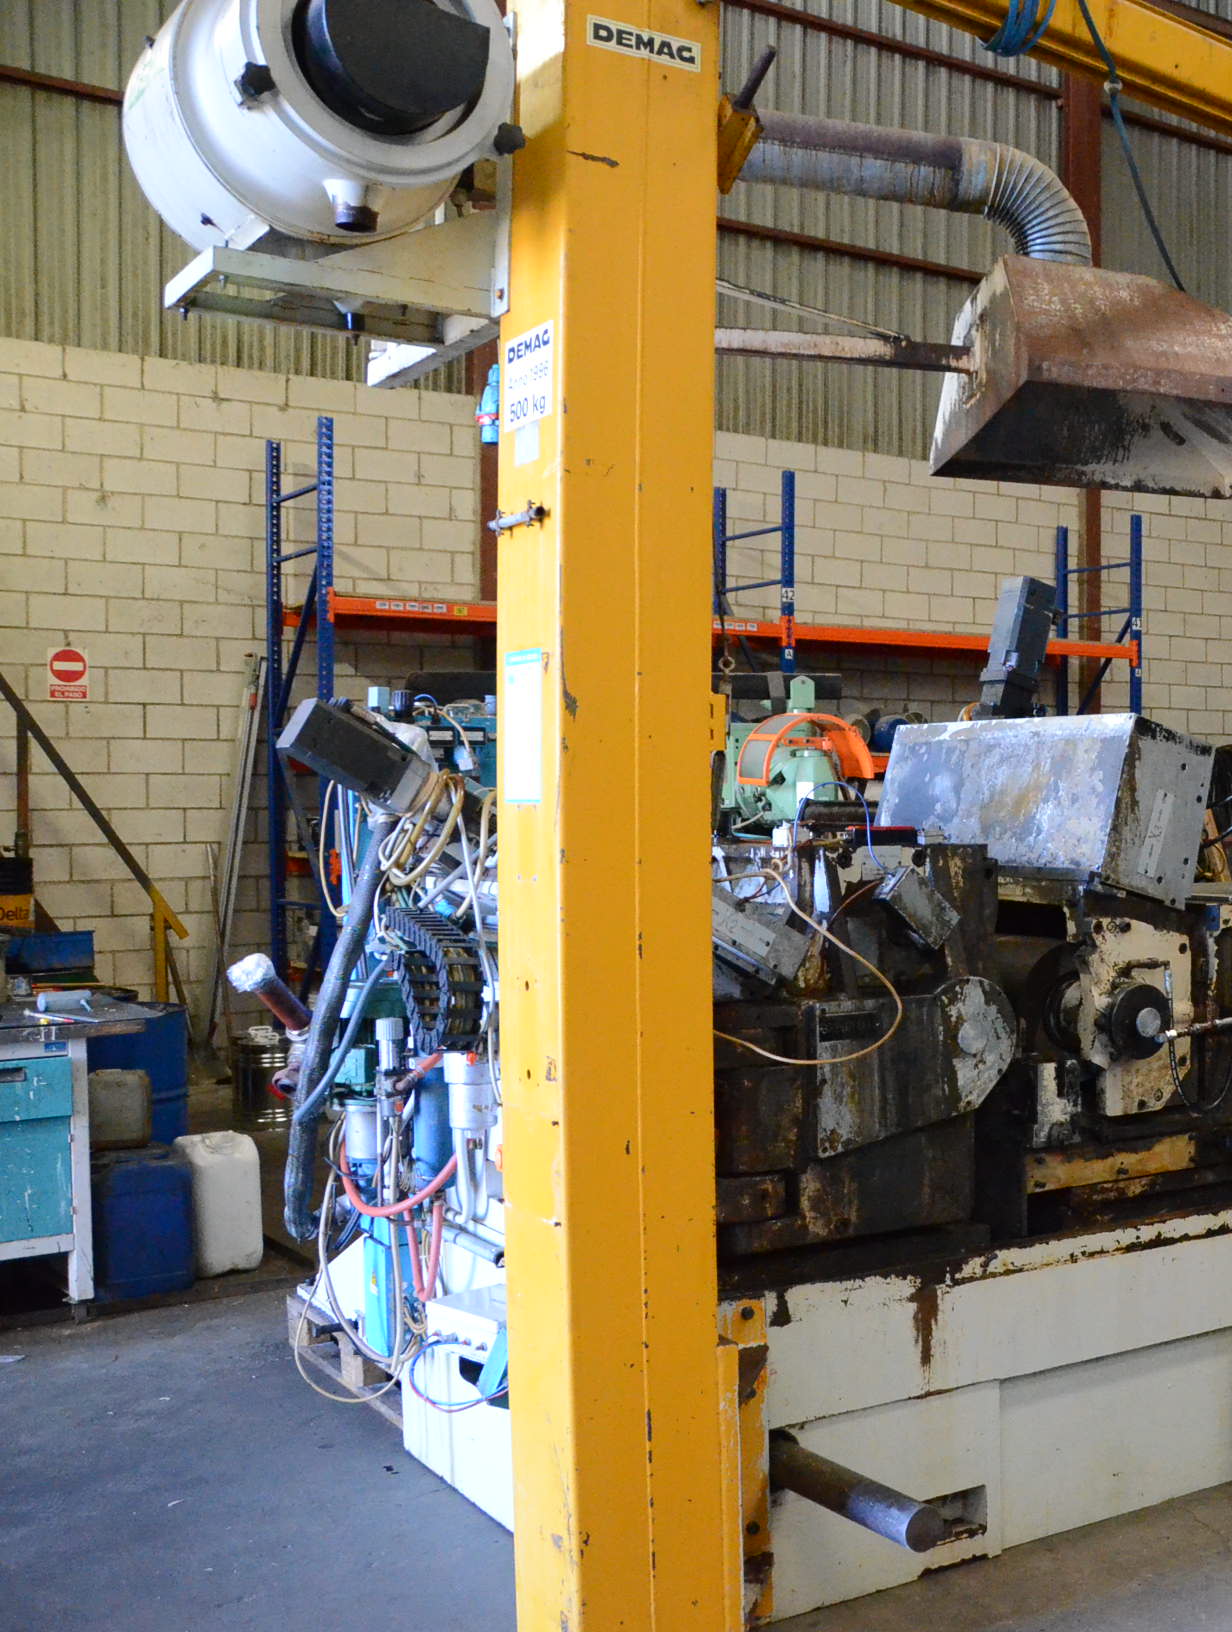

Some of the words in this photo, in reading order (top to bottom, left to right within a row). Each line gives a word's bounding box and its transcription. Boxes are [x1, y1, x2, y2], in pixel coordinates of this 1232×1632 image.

[593, 22, 696, 65] DEMAG
[507, 328, 550, 364] DEMAG
[510, 397, 528, 422] 500
[532, 394, 546, 417] kg
[782, 590, 795, 600] 42
